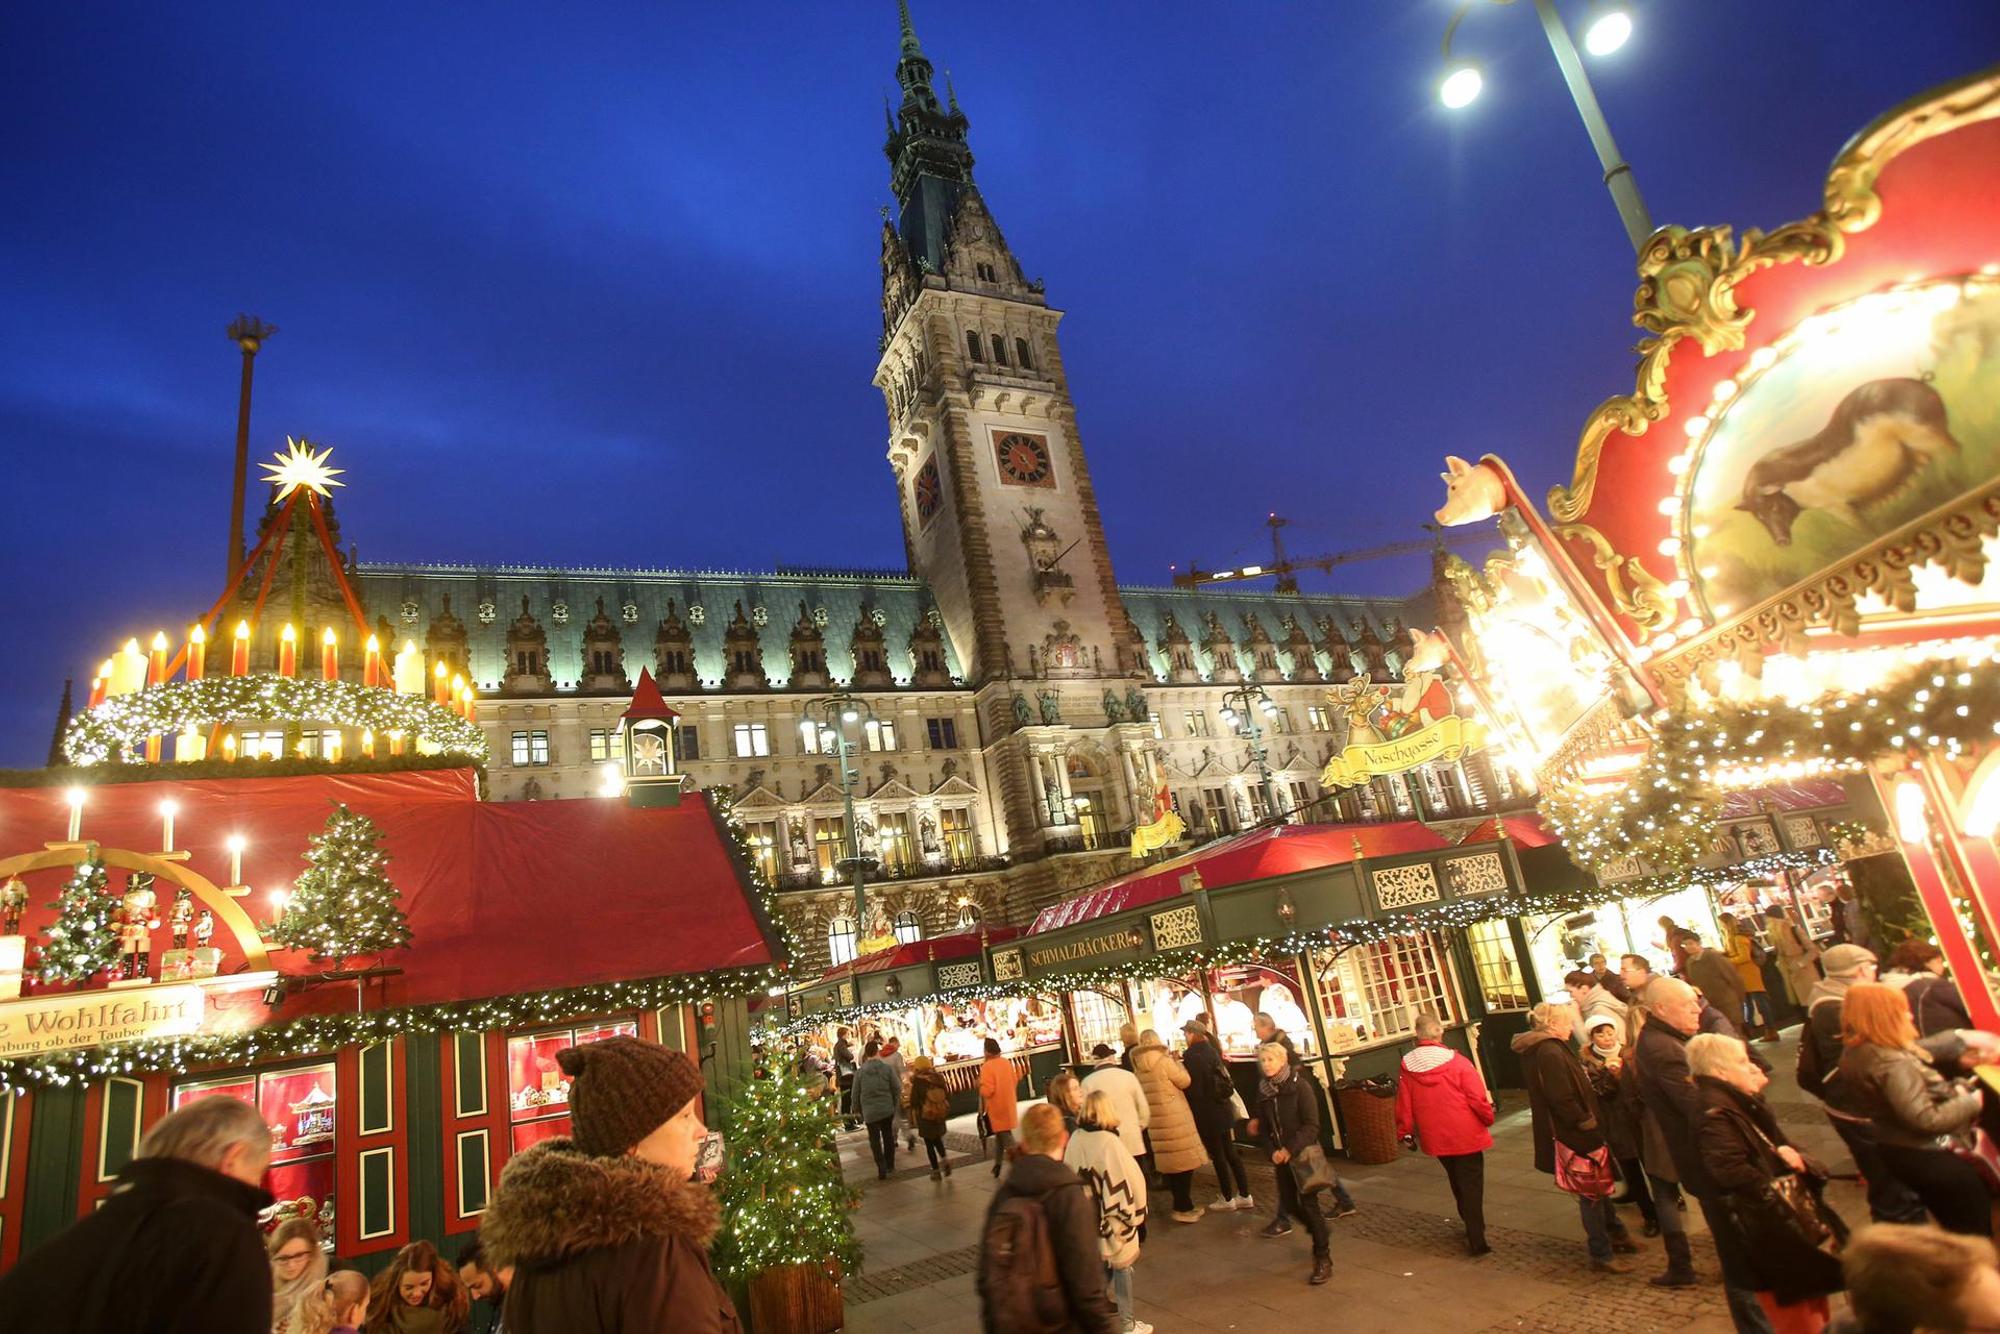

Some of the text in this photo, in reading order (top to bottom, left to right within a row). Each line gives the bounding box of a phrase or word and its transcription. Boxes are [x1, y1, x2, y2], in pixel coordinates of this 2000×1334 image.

[1364, 731, 1440, 766] Naschgasse
[1031, 931, 1136, 966] SCHMALZBÄCKER
[26, 1000, 187, 1034] Wohlfahrt
[45, 1036, 63, 1047] ob
[69, 1033, 93, 1045] der
[98, 1028, 146, 1041] Tauber
